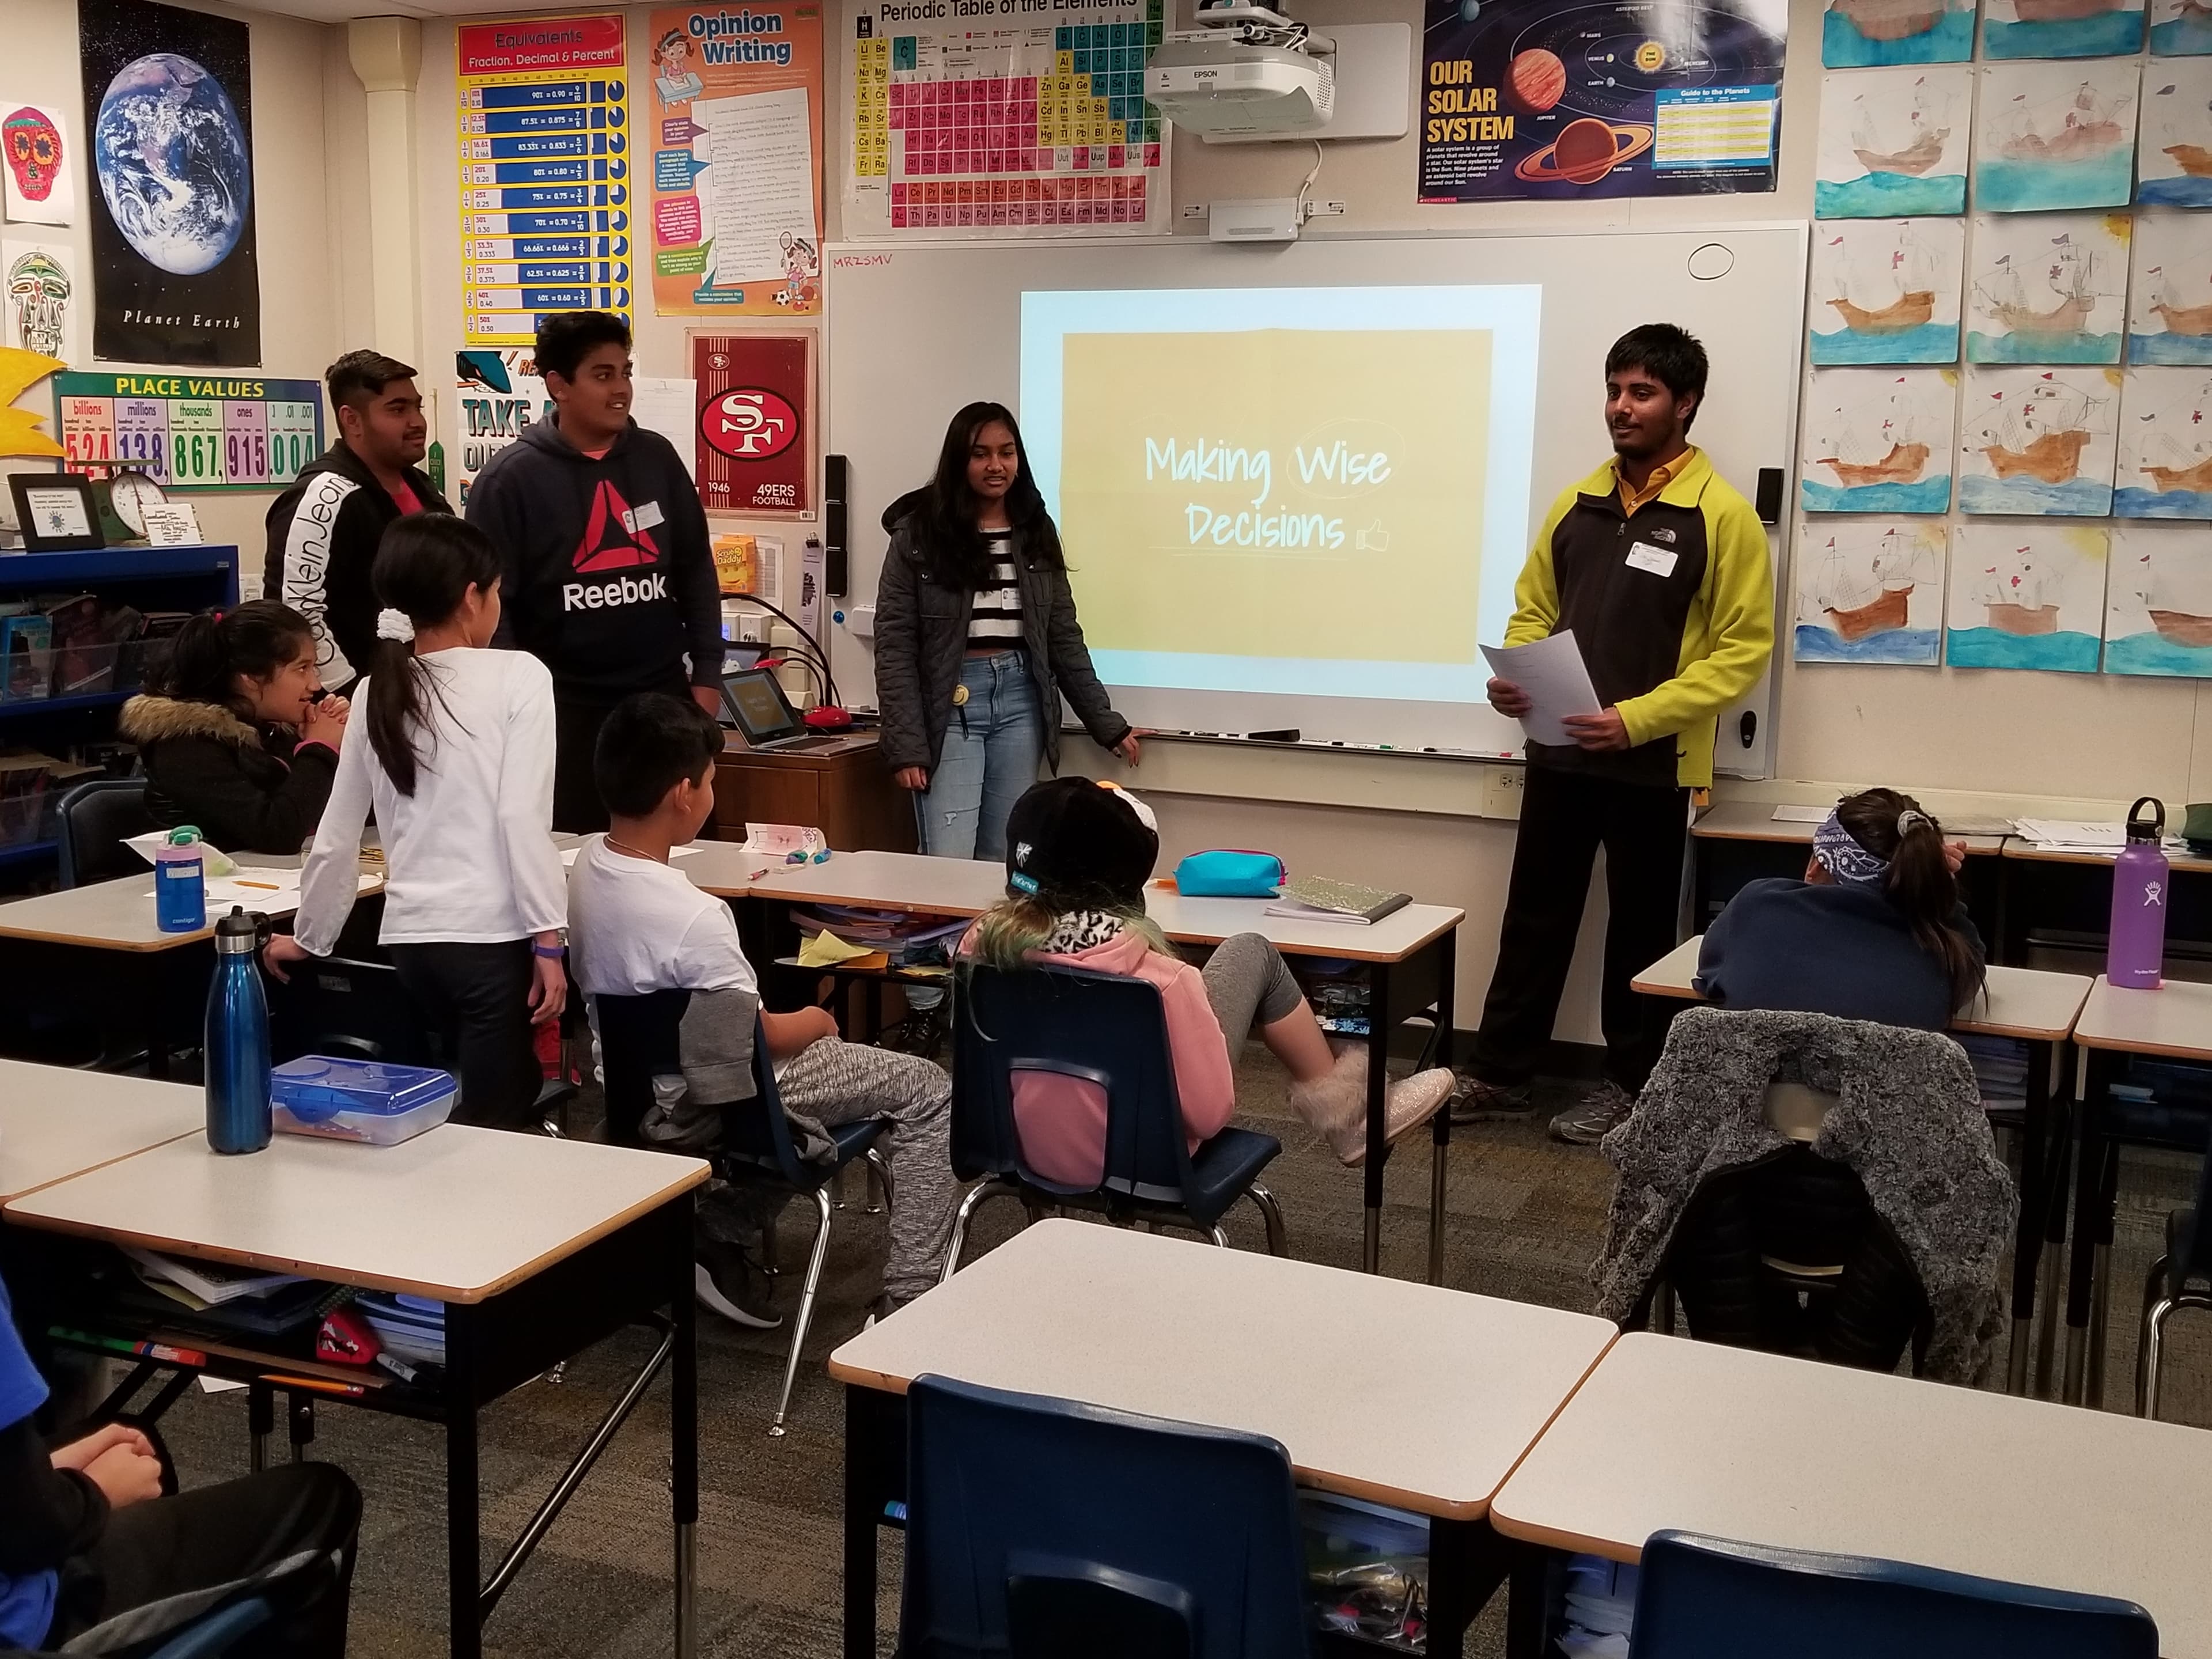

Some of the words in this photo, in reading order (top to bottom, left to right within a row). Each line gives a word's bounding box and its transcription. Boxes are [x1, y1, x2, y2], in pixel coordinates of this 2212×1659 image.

[881, 2, 946, 22] Periodic
[951, 0, 994, 16] Table
[1000, 0, 1017, 14] of
[1021, 0, 1047, 12] the
[689, 10, 781, 40] Opinion
[495, 29, 582, 48] Equivalents
[469, 57, 513, 67] Fraction,
[516, 52, 559, 65] Decimal
[573, 50, 614, 60] Percent
[702, 39, 791, 65] Writing
[875, 69, 886, 78] Mg
[1430, 60, 1473, 85] OUR
[1041, 82, 1051, 90] Zn
[1059, 82, 1070, 90] Ga
[1077, 81, 1088, 89] Ge
[1429, 88, 1497, 114] SOLAR
[1041, 107, 1052, 115] Cd
[1076, 105, 1087, 113] Sn
[1041, 131, 1052, 141] Hg
[1112, 127, 1122, 135] Po
[1427, 116, 1514, 143] SYSTEM
[1091, 153, 1104, 162] Uup
[960, 210, 970, 220] Np
[1113, 206, 1124, 214] No
[123, 310, 181, 326] Planet
[193, 314, 241, 329] Earth
[518, 359, 539, 376] RE
[116, 377, 181, 395] PLACE
[188, 380, 264, 397] VALUES
[73, 400, 102, 415] billions
[127, 401, 156, 416] millions
[180, 403, 213, 417] thousands
[237, 407, 252, 418] ones
[462, 399, 531, 437] TAKE
[722, 394, 783, 453] SF
[1145, 437, 1271, 507] Making
[1295, 440, 1392, 485] Wise
[708, 482, 730, 493] 1946
[757, 484, 795, 497] 49ERS
[752, 496, 796, 506] FOOTBALL
[1185, 502, 1346, 550] Decisions
[717, 549, 734, 557] Scrub
[717, 555, 741, 565] Daddy
[287, 540, 325, 599] Klein
[563, 573, 667, 611] Reebok
